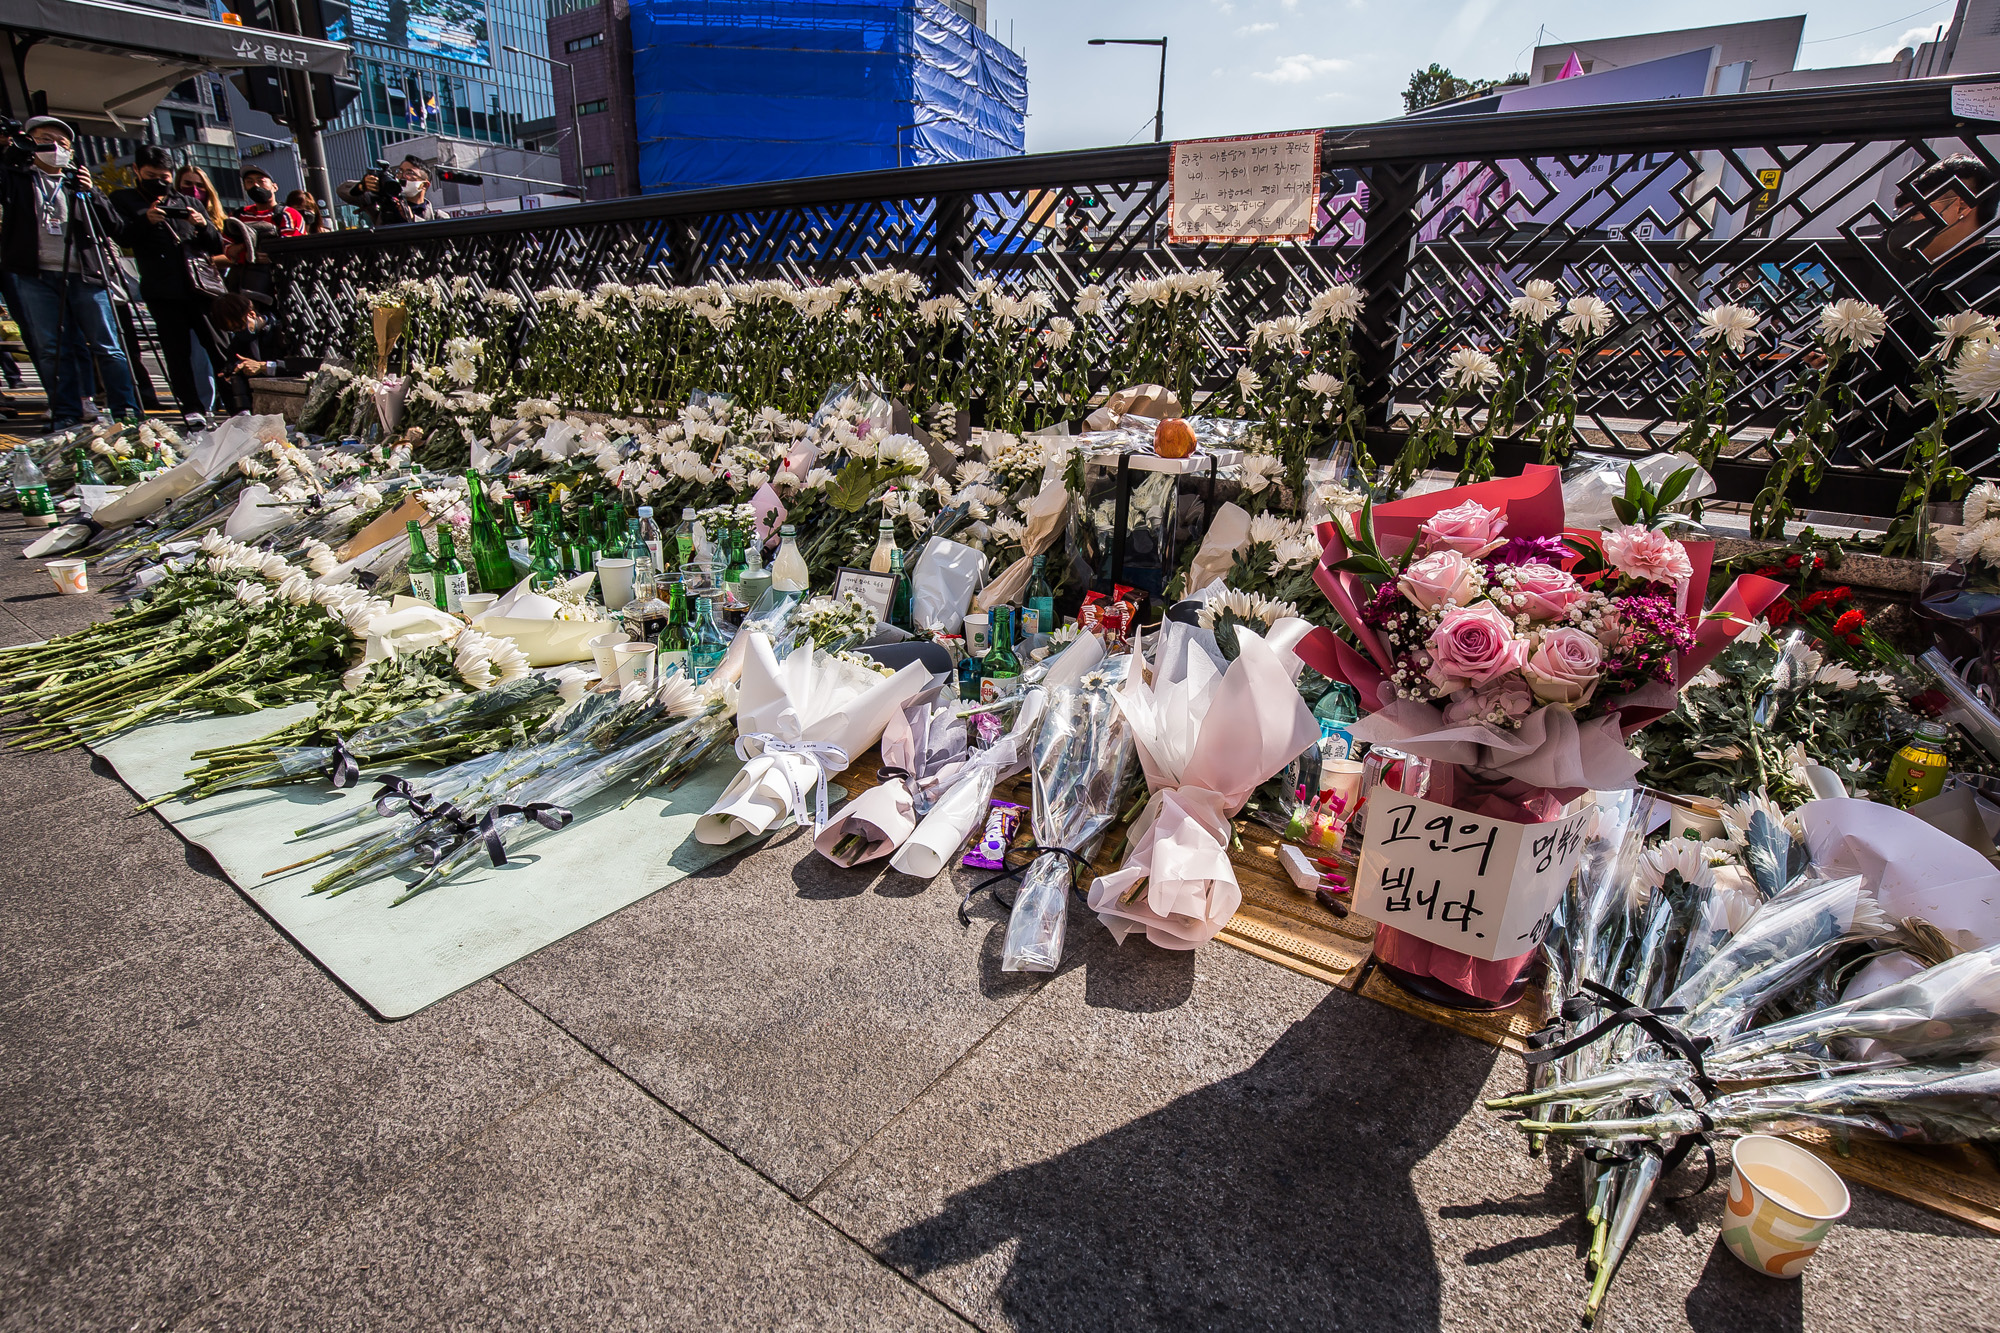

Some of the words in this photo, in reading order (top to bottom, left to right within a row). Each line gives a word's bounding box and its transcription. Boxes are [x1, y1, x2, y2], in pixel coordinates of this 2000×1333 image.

[263, 44, 309, 66] 용산구
[1218, 187, 1253, 200] 하늘에서
[1260, 184, 1280, 195] 편히
[1760, 192, 1769, 203] 4
[413, 578, 432, 601] 참이슬
[1532, 816, 1587, 874] 명복을
[1381, 866, 1485, 939] 빕니다.
